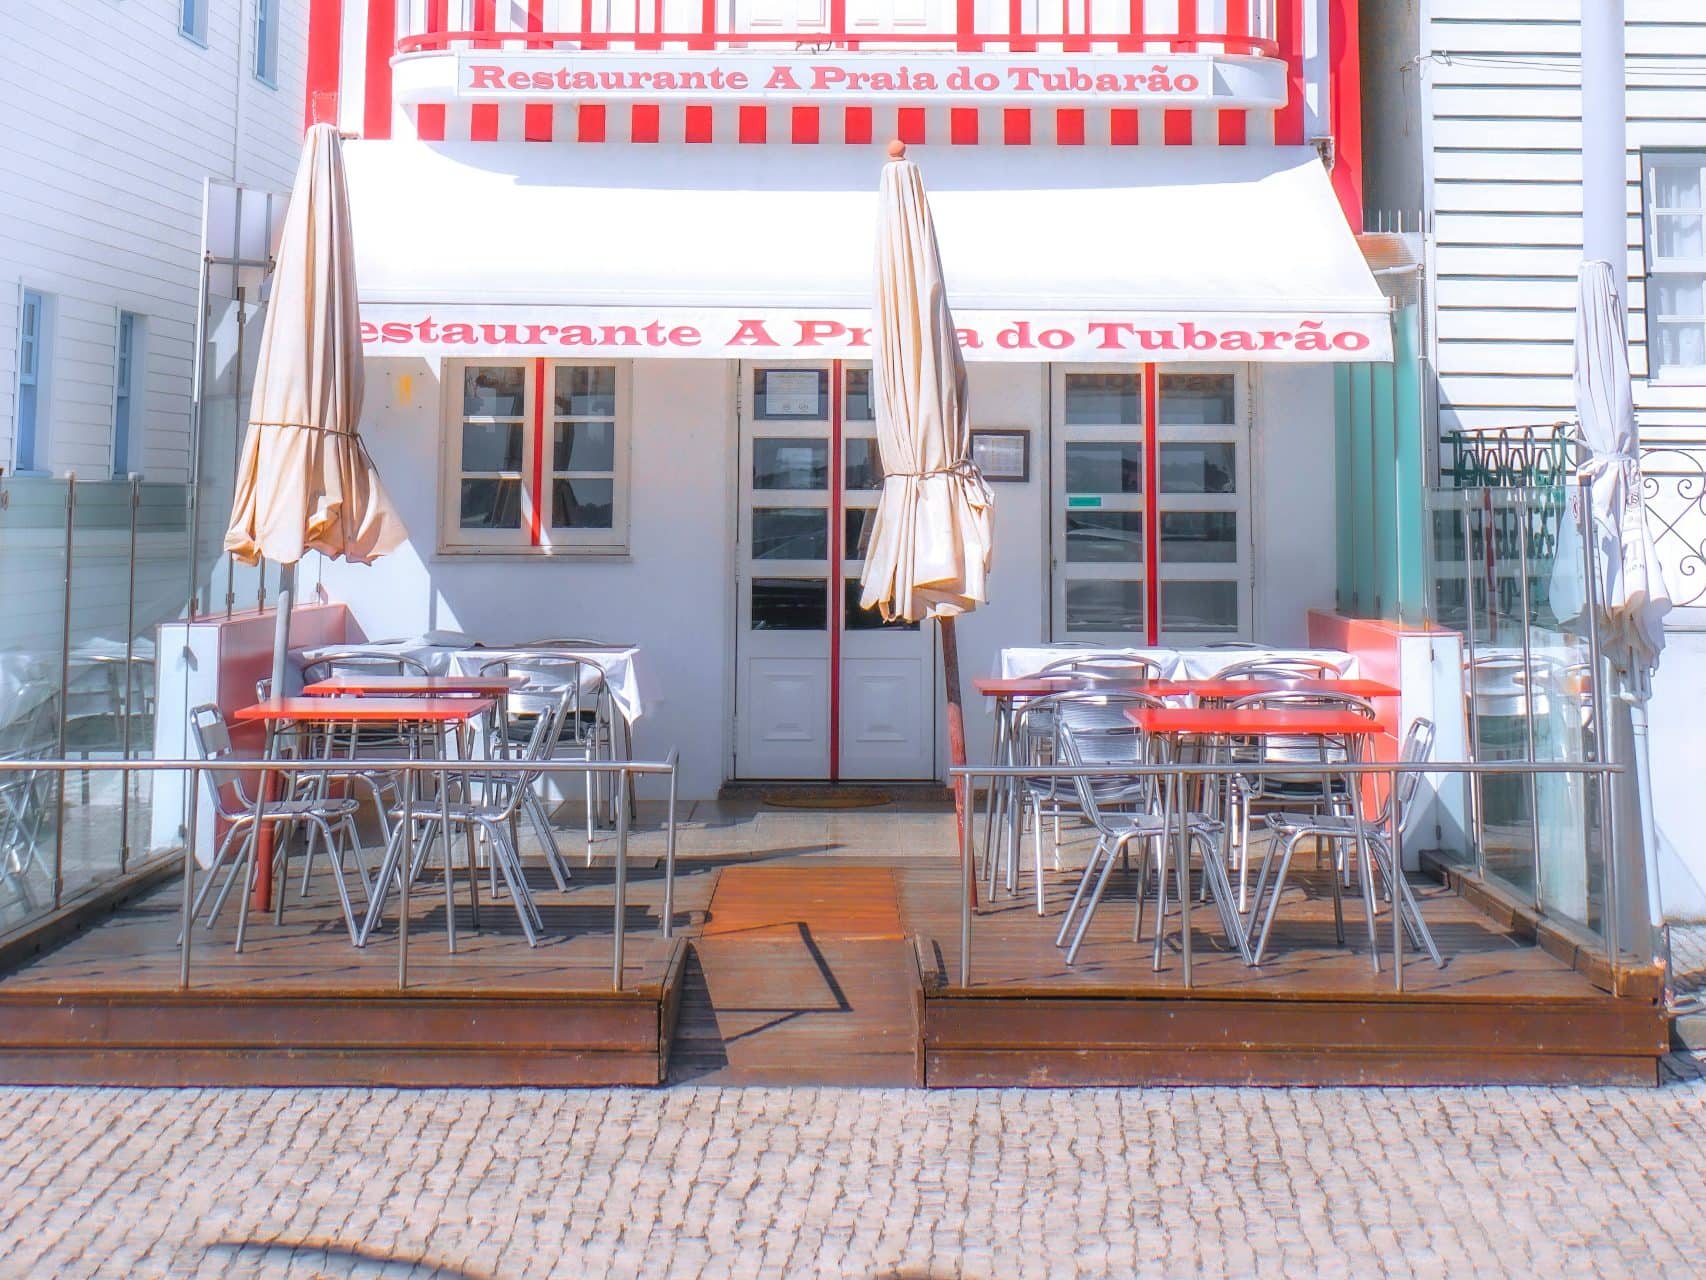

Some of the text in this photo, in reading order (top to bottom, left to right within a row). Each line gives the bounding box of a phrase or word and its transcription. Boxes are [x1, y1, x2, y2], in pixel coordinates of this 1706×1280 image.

[469, 64, 1200, 92] Restaurante A Praia do Tubarão
[359, 316, 1371, 351] estaurante A Pra do Tubarão
